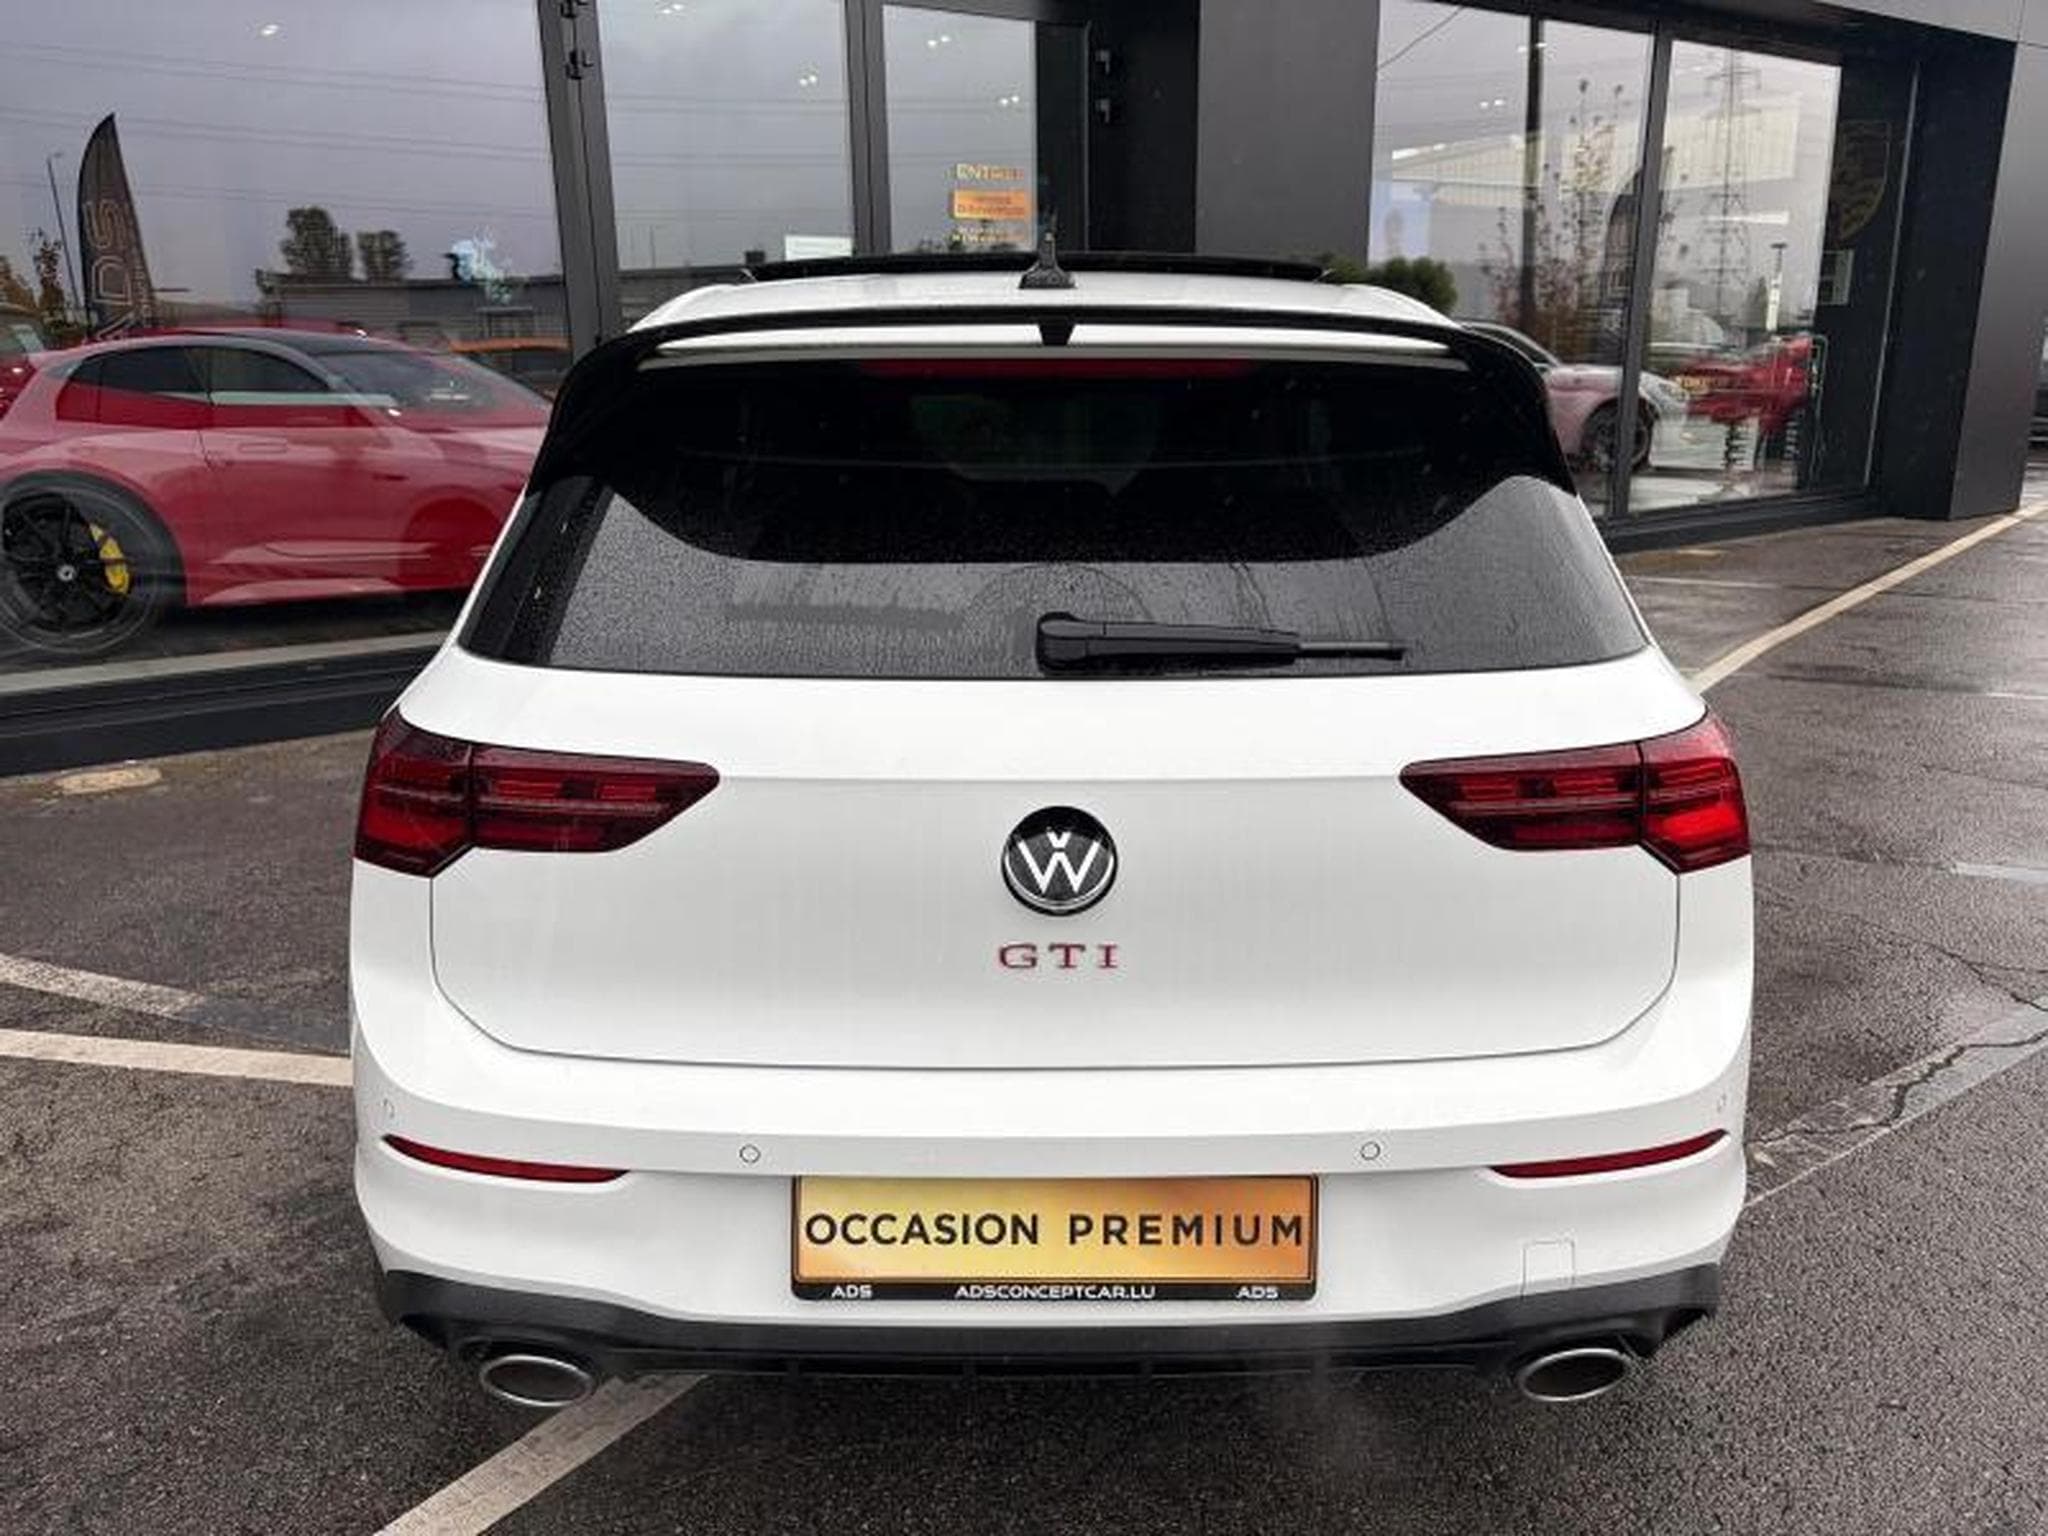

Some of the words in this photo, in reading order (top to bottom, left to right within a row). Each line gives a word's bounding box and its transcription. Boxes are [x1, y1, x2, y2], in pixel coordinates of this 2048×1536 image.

[1000, 942, 1118, 969] GTI
[805, 1213, 1039, 1245] OCCASION
[1069, 1213, 1303, 1246] PREMIUM
[831, 1285, 872, 1299] ADS
[955, 1285, 1156, 1299] ADSCONCEPTCAR.LU
[1235, 1285, 1280, 1299] ADS
